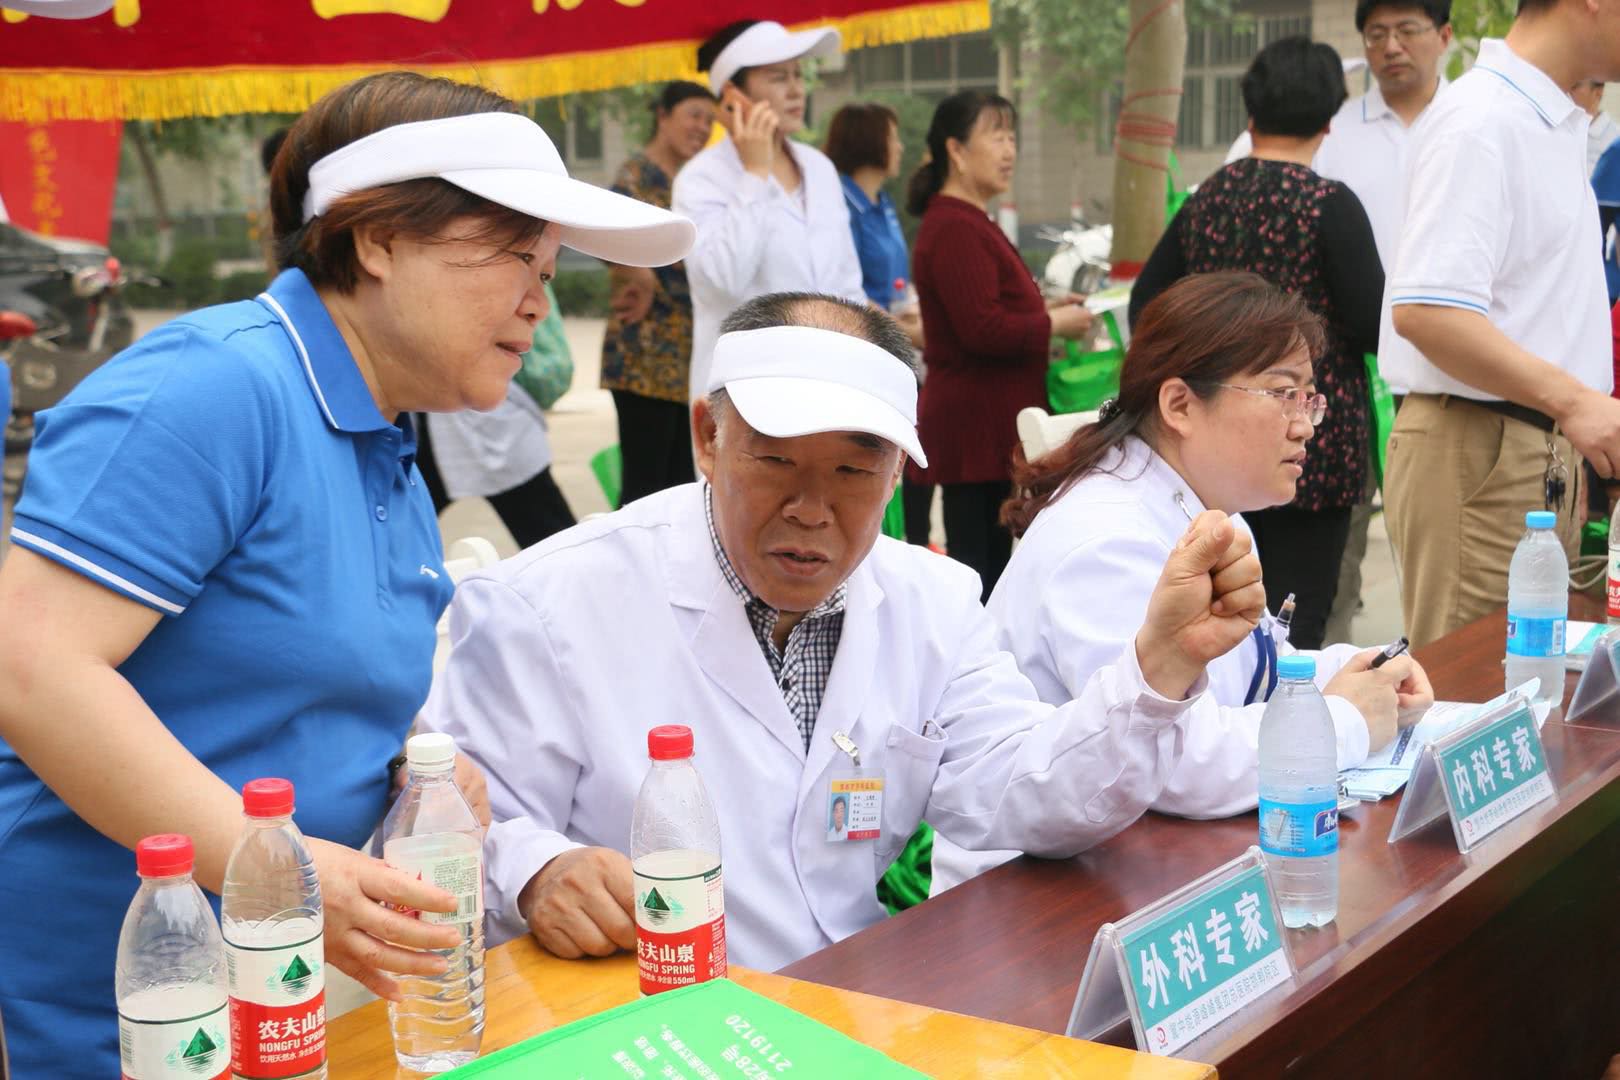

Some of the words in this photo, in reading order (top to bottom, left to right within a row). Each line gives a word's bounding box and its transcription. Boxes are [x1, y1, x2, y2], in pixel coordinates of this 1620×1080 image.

[1453, 726, 1536, 809] 内科专家
[661, 964, 695, 974] SPRING
[1139, 891, 1269, 1009] 外科专家
[259, 1039, 300, 1052] NONGFU
[725, 1015, 792, 1073] 2119120
